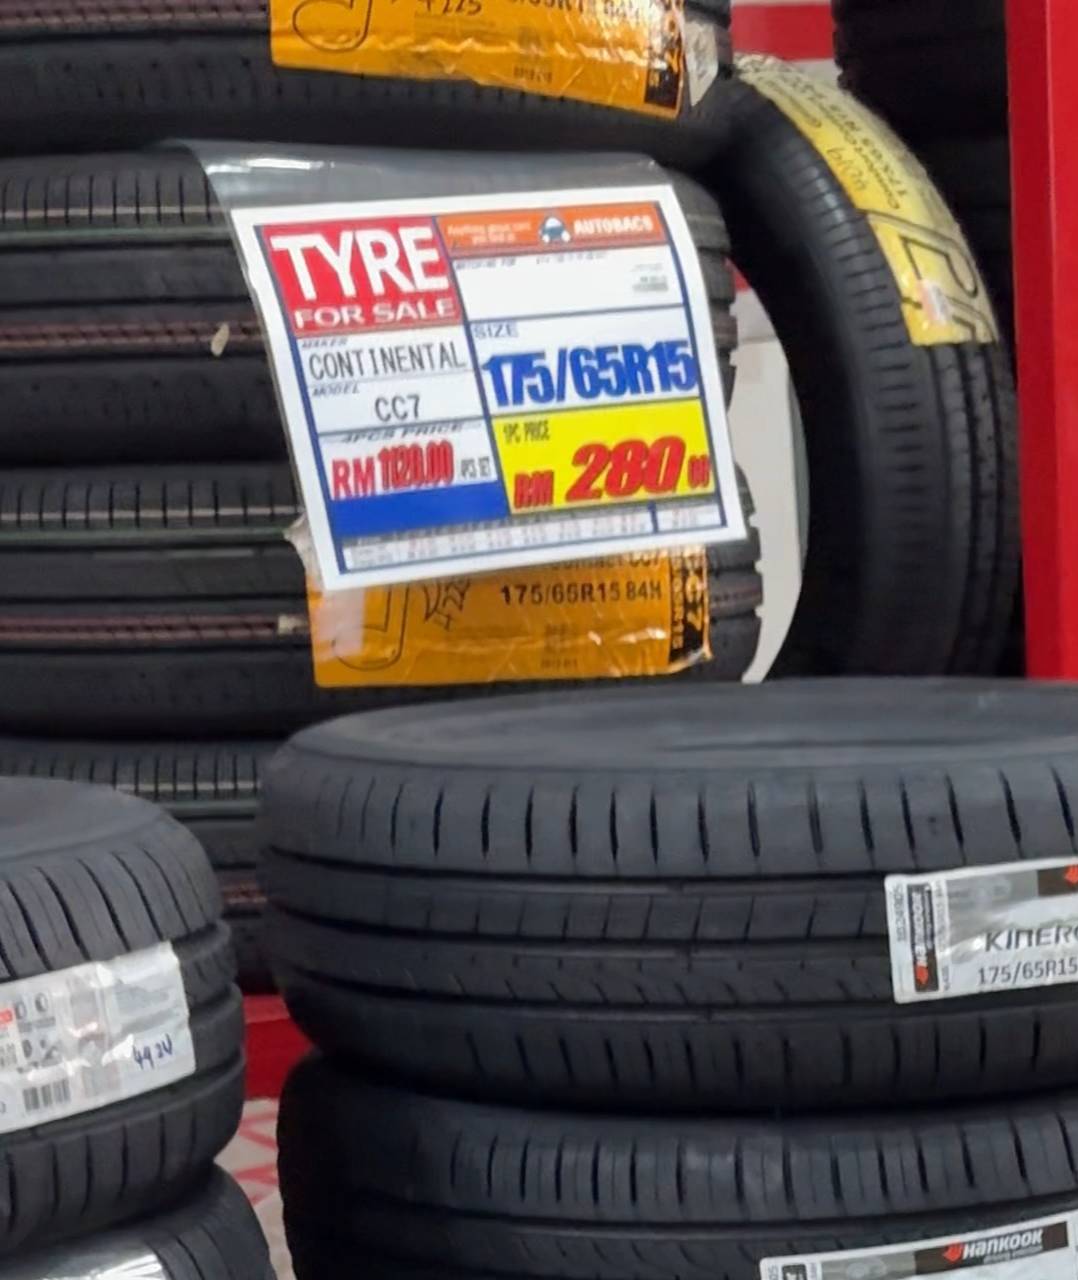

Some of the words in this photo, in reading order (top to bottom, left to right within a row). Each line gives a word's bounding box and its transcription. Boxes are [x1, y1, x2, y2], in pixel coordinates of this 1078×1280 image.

[573, 215, 654, 235] AUTOBACS
[270, 226, 449, 301] TYRE
[294, 304, 365, 329] FOR
[372, 297, 457, 324] SALE
[473, 322, 519, 339] SIZE
[308, 341, 466, 381] CONTINENTAL
[481, 340, 698, 407] 175/65R15
[375, 394, 421, 422] CC7
[523, 420, 551, 442] PRICE
[331, 455, 376, 500] RM
[514, 470, 554, 510] RM
[565, 435, 686, 502] 280
[501, 581, 620, 607] 175/65R15
[978, 956, 1078, 986] 175/65R15
